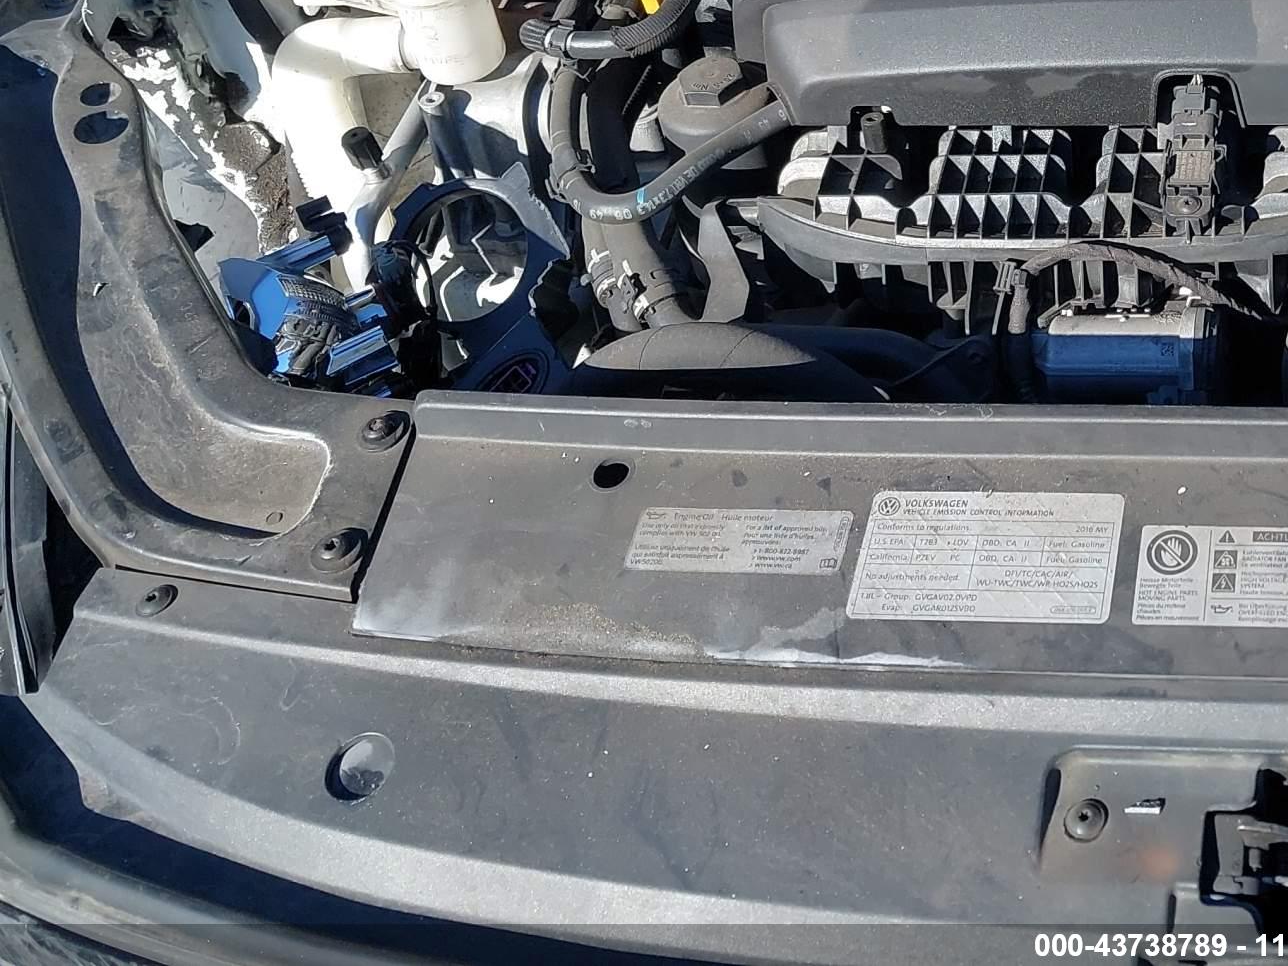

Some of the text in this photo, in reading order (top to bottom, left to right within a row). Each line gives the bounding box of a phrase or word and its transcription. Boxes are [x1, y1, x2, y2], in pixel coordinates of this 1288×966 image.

[905, 499, 969, 508] VOLKSWAGEN
[674, 513, 701, 522] Engine
[1005, 509, 1054, 517] INFORMATION
[877, 523, 915, 531] Conforms
[916, 523, 925, 531] to
[1005, 539, 1017, 547] CA
[1070, 540, 1106, 548] Gasoline
[1068, 556, 1103, 564] Gasoline
[865, 572, 877, 580] No
[878, 572, 927, 582] adjustments
